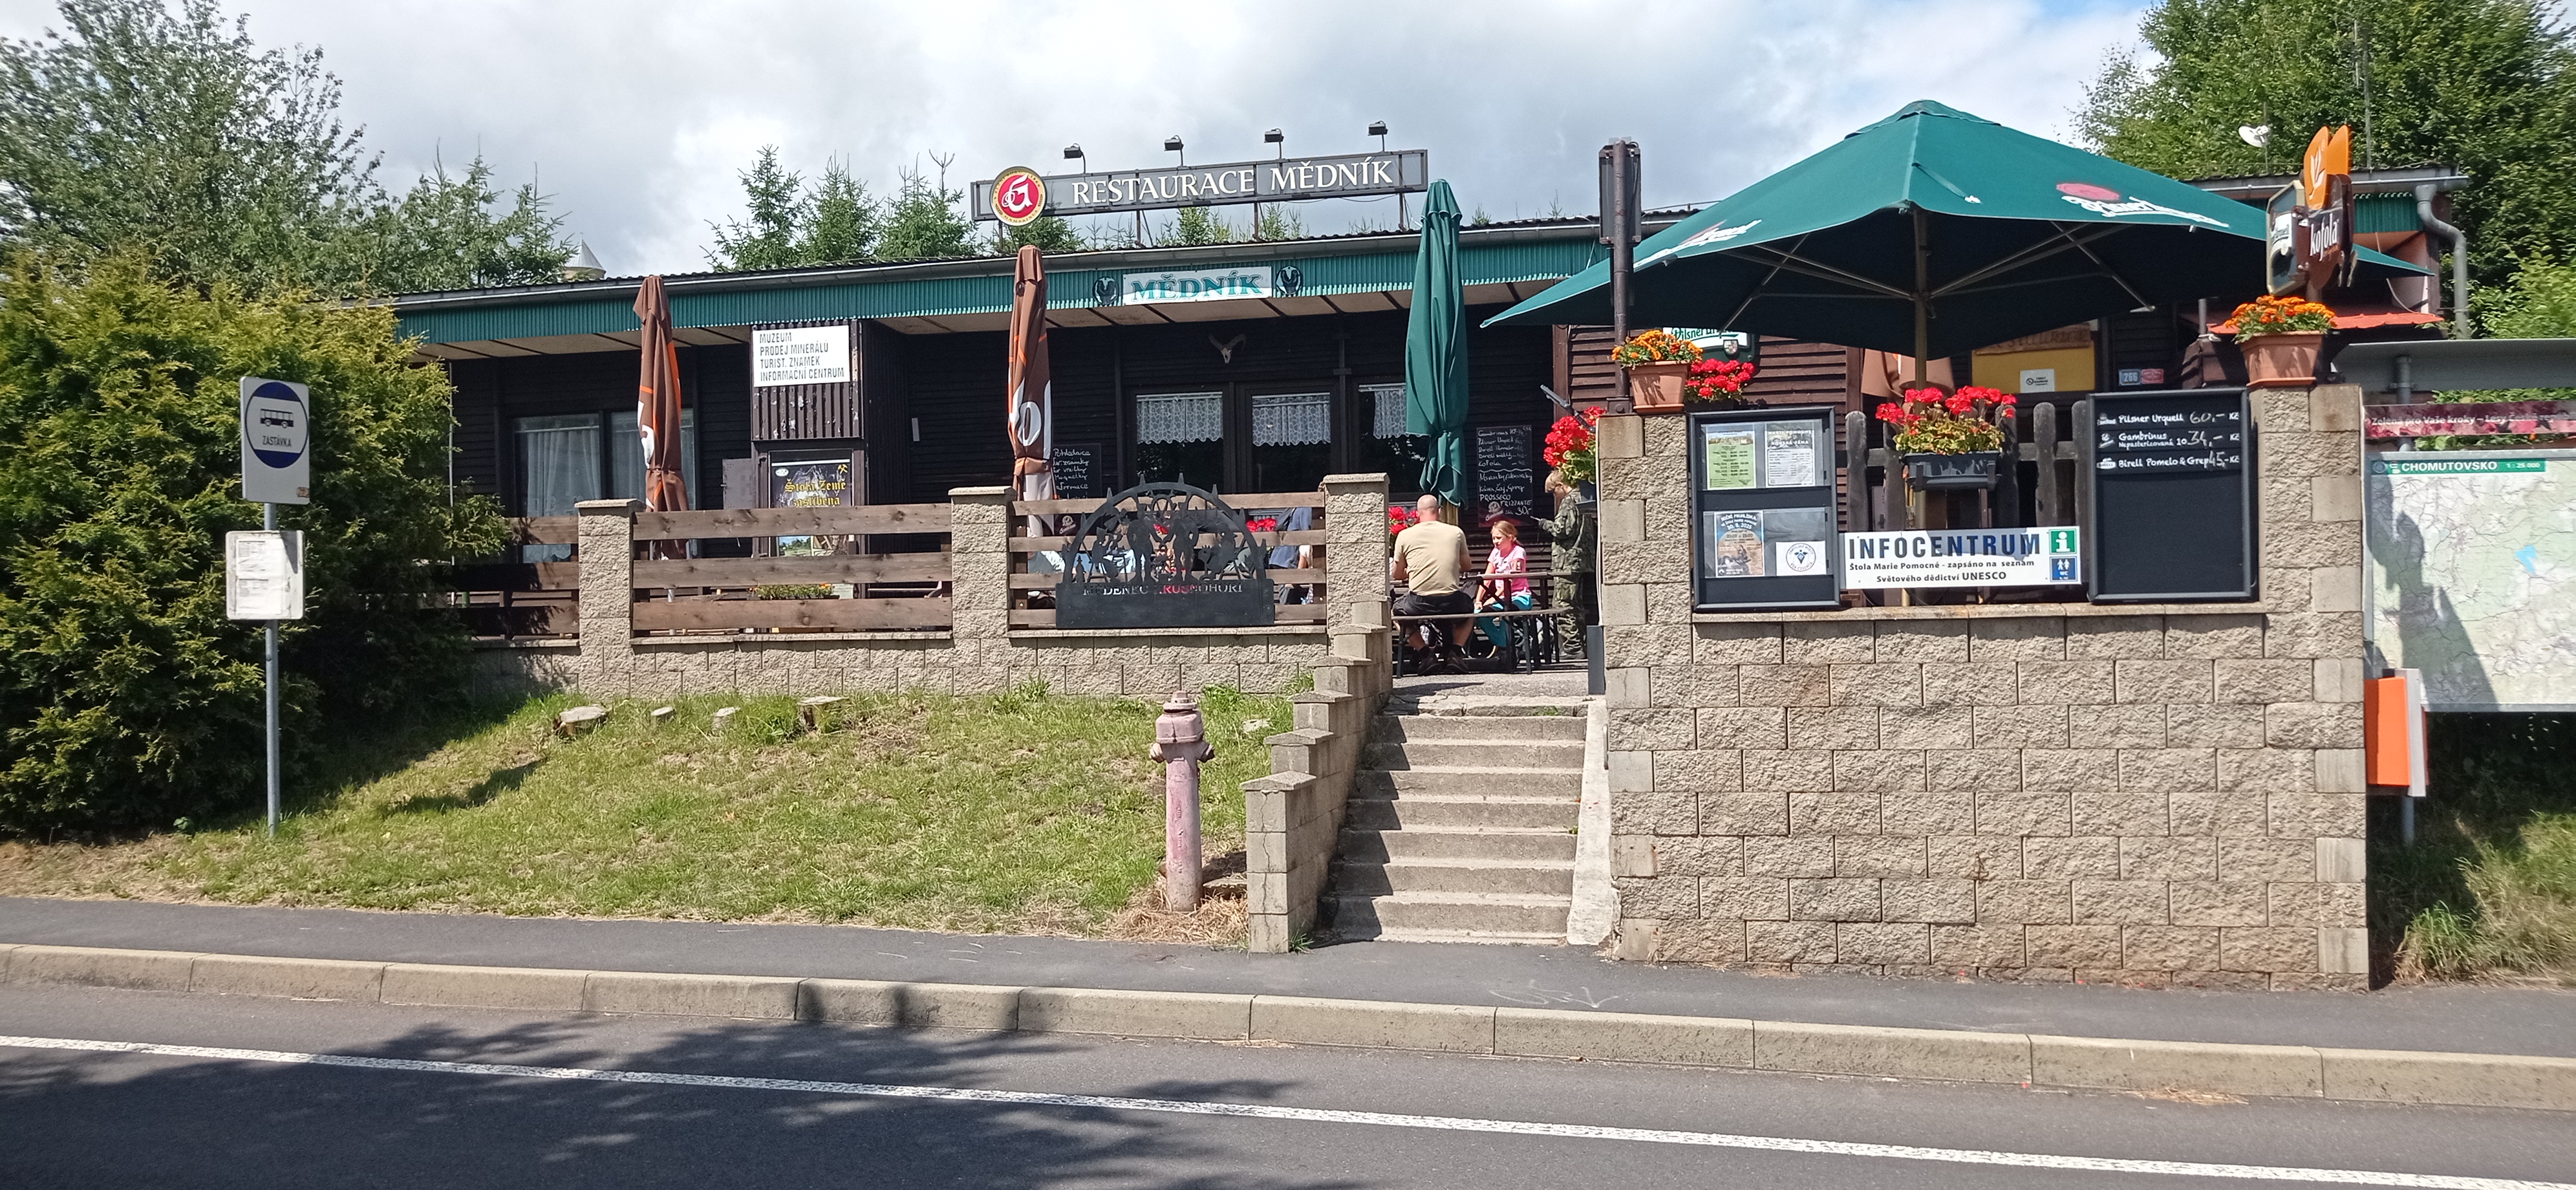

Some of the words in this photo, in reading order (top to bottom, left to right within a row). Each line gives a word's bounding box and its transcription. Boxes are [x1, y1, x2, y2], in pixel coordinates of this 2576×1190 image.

[1071, 169, 1255, 204] RESTAURACE
[1270, 157, 1393, 191] MĚDNÍK
[2310, 213, 2339, 262] kofola
[1132, 270, 1263, 301] MĚDNÍK
[760, 332, 791, 343] MUZEUM
[760, 345, 788, 356] PRODEJ
[791, 340, 828, 354] MINERÁLŮ
[760, 358, 787, 369] TURIST.
[789, 356, 820, 367] ZNAMEK
[760, 367, 806, 382] INFORMAČNÍ
[809, 367, 844, 379] CENTRUM
[2123, 372, 2138, 382] 266
[2119, 414, 2150, 424] Pilsner
[2152, 413, 2184, 426] Urquell
[2405, 417, 2421, 426] pro
[2424, 416, 2445, 425] Vaše
[2446, 415, 2475, 425] kroky
[263, 434, 292, 448] ZASTÁVKA
[2119, 431, 2167, 441] Gambrinus
[2229, 433, 2240, 441] Kč
[2119, 440, 2174, 451] Nepasterizovaná
[1053, 448, 1091, 457] Pohlednice
[2119, 459, 2143, 468] Birell
[2146, 458, 2178, 467] Pomelo
[2180, 457, 2186, 466] &
[2187, 457, 2209, 469] Grep
[2229, 454, 2240, 464] Kč
[2401, 461, 2498, 471] CHOMUTOVSKO
[785, 479, 815, 492] Štola
[819, 478, 846, 490] Země
[1849, 534, 2040, 559] INFOCENTRUM
[1849, 561, 1871, 570] Štola
[1874, 562, 1898, 570] Marie
[1900, 561, 1940, 570] Pomocné
[1948, 561, 1984, 570] zapsáno
[1876, 574, 1922, 583] Světového
[1924, 573, 1960, 581] dědictví
[1962, 571, 2006, 581] UNESCO
